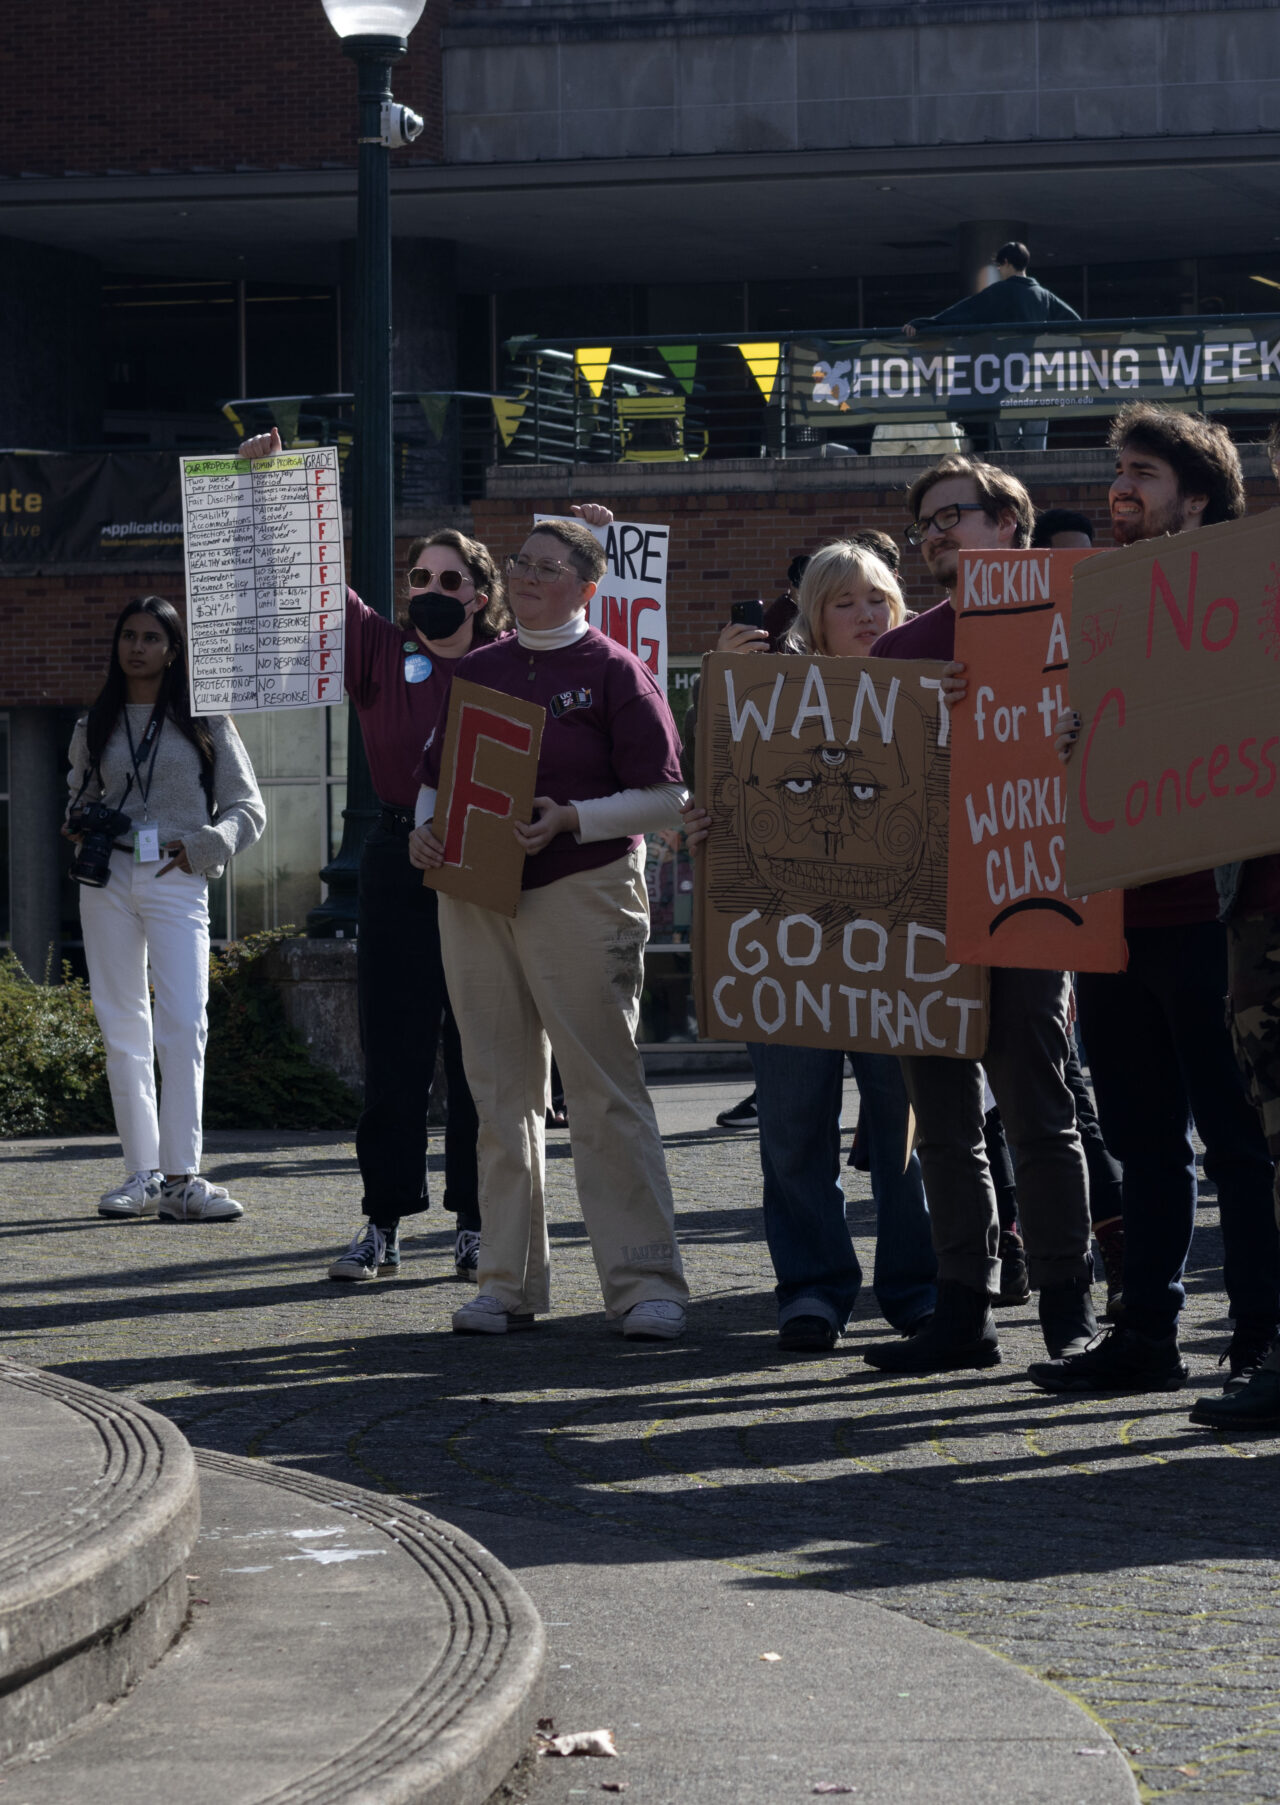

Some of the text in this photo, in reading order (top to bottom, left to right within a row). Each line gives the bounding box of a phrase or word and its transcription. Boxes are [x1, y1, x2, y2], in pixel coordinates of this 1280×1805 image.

[853, 346, 1140, 399] HOMECOMING
[1000, 395, 1094, 407] calendar.uoregon.edu
[185, 460, 241, 474] OUR PROPOSAL
[277, 457, 305, 468] PROPOSAL
[305, 452, 333, 468] GRADE
[186, 475, 230, 487] Two week
[209, 480, 235, 490] period
[256, 476, 282, 487] period
[315, 469, 325, 486] F
[187, 492, 245, 507] Fair Discipline
[316, 486, 326, 501] F
[189, 509, 230, 523] Disability
[317, 503, 324, 519] F
[192, 516, 252, 530] Accommodations
[189, 530, 226, 539] Protections
[318, 522, 326, 541] F
[319, 545, 327, 562] F
[605, 525, 668, 584] ARE
[190, 558, 221, 569] HEALTHY
[267, 565, 291, 574] should
[191, 572, 235, 583] Independent
[256, 572, 300, 582] investigate
[319, 565, 328, 585] F
[219, 592, 234, 601] set
[258, 597, 300, 609] until 2029
[320, 590, 330, 608] F
[1145, 550, 1240, 660] No
[258, 616, 309, 630] NO RESPONSE
[319, 614, 328, 631] F
[193, 638, 218, 647] Access
[258, 634, 308, 648] NO RESPONSE
[319, 633, 328, 649] F
[1045, 612, 1069, 665] A
[194, 656, 223, 665] Access
[258, 655, 310, 670] NO RESPONSE
[320, 652, 331, 671] F
[196, 665, 244, 676] break rooms
[194, 677, 243, 691] PROTECTION
[258, 677, 276, 693] NO
[317, 677, 330, 700] F
[196, 691, 231, 705] CULTURAL
[263, 690, 308, 706] RESPONSE
[724, 664, 952, 748] WANT
[973, 685, 1028, 743] for
[444, 700, 533, 868] F
[727, 908, 961, 983] GOOD
[712, 974, 983, 1055] CONTRACT
